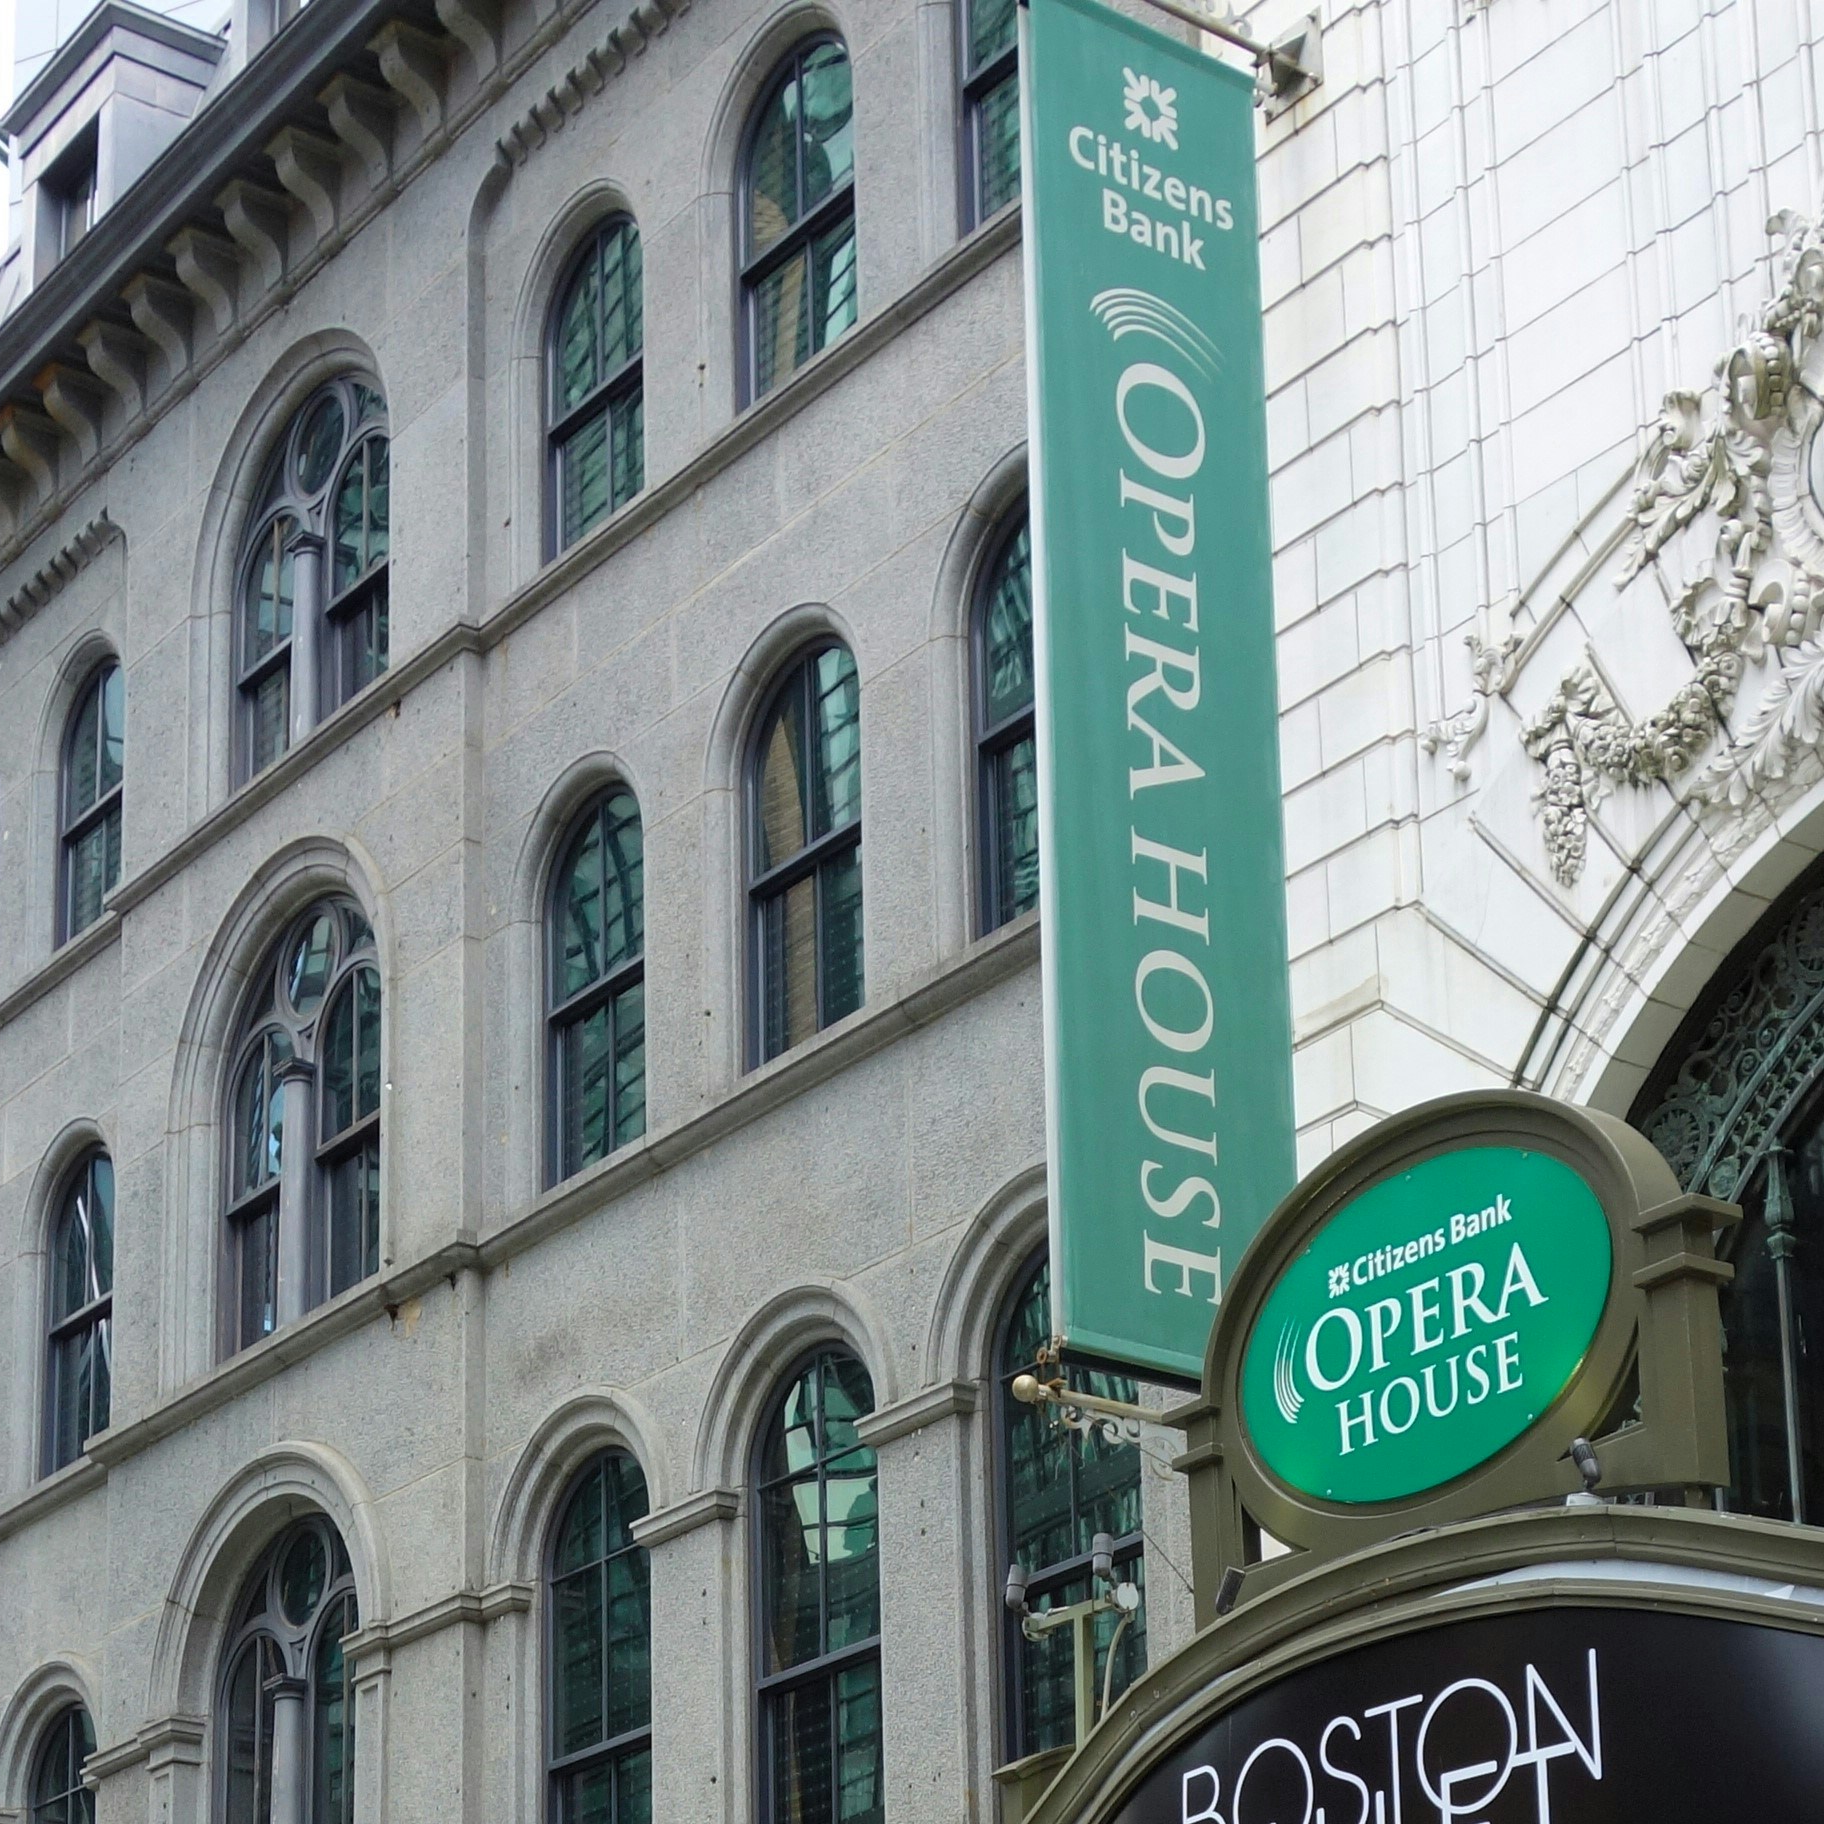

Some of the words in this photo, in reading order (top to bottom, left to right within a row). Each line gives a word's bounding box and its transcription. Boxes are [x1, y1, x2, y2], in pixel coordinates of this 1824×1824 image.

[1068, 125, 1234, 232] Citizens
[1102, 188, 1206, 271] Bank
[1115, 362, 1206, 800] OPERA
[1131, 825, 1224, 1306] HOUSE
[1352, 1224, 1446, 1286] Citizens
[1449, 1194, 1513, 1246] Bank
[1305, 1242, 1550, 1392] OPERA
[1335, 1331, 1524, 1457] HOUSE
